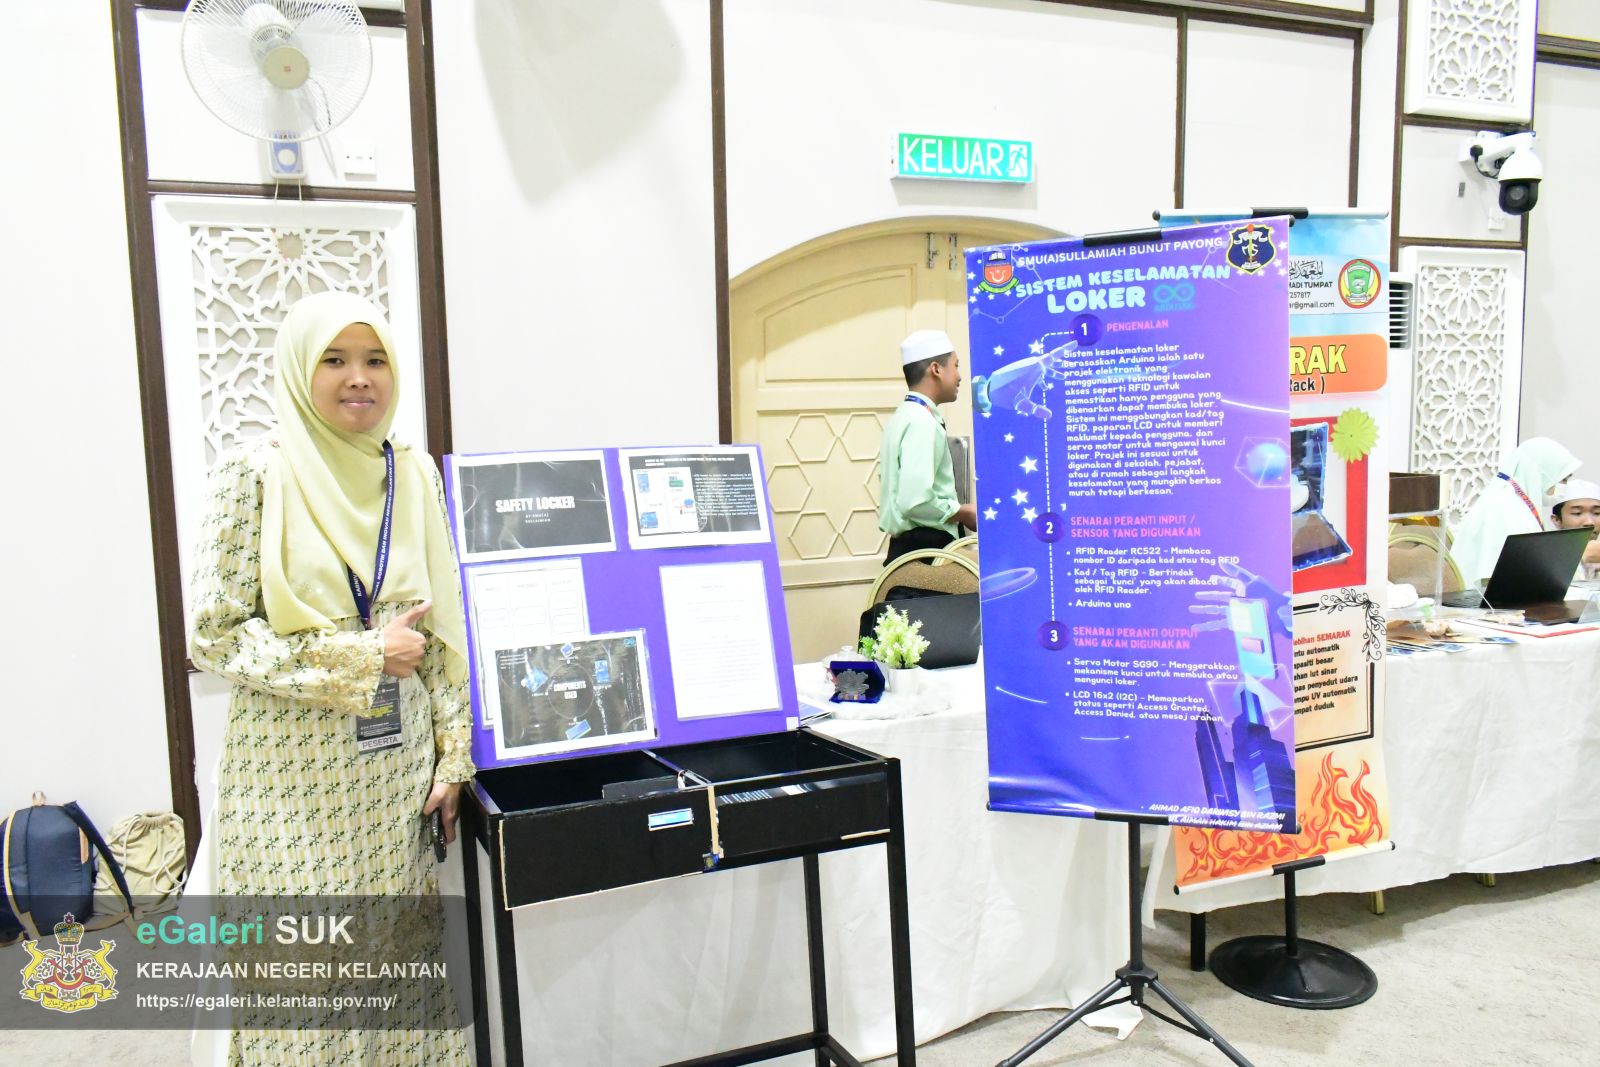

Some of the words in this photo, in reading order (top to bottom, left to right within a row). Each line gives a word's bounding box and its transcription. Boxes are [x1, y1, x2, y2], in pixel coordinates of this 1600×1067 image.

[903, 137, 1004, 176] KELUAR
[1018, 246, 1126, 267] SMU(A)SULLAMIAH
[1129, 242, 1170, 256] BUNUT
[1174, 237, 1222, 252] PAYONG
[1016, 277, 1083, 298] SISTEM
[1089, 265, 1231, 286] KESELAMATAN
[1046, 286, 1146, 314] LOKER
[1080, 323, 1087, 335] 1
[1107, 321, 1169, 332] PENGENALAN
[1064, 350, 1093, 358] Sistem
[1095, 346, 1153, 357] keselamatan
[1119, 356, 1155, 364] Arduino
[1064, 369, 1093, 378] projek
[1096, 365, 1141, 375] elektronik
[1128, 374, 1170, 383] teknologi
[1173, 372, 1211, 380] kawalan
[1093, 386, 1126, 395] seperti
[1154, 382, 1180, 390] untuk
[1066, 395, 1116, 405] memastikan
[1120, 394, 1147, 403] hanya
[1151, 392, 1194, 401] pengguna
[1066, 405, 1114, 414] dibenarkan
[1118, 404, 1144, 413] dapat
[1093, 424, 1131, 433] paparan
[1156, 420, 1181, 428] untuk
[1110, 432, 1142, 442] kepada
[1155, 439, 1199, 448] mengawal
[1094, 452, 1124, 460] Projek
[1068, 461, 1111, 470] digunakan
[1132, 468, 1167, 478] sebagai
[1170, 468, 1206, 476] langkah
[1126, 479, 1148, 488] yang
[1151, 478, 1186, 486] mungkin
[1098, 488, 1126, 497] tetapi
[496, 498, 533, 513] SAFETY
[536, 496, 575, 510] LOCKER
[1071, 516, 1112, 526] SENARAI
[1115, 515, 1156, 525] PERANTI
[1159, 514, 1187, 524] INPUT
[1046, 522, 1054, 534] 2
[1071, 528, 1109, 538] SENSOR
[1113, 528, 1138, 538] YANG
[1140, 527, 1201, 537] DIGUNAKAN
[1098, 547, 1128, 555] Reader
[1171, 547, 1211, 555] Membaca
[1074, 556, 1104, 564] nombor
[1118, 556, 1156, 566] daripada
[1200, 557, 1215, 566] tag
[1099, 568, 1115, 578] Tag
[1118, 569, 1138, 577] RFID
[1074, 578, 1107, 586] sebagai
[1140, 578, 1162, 587] yang
[1164, 578, 1186, 586] akan
[1075, 585, 1092, 593] oleh
[1076, 600, 1111, 608] Arduino
[1050, 630, 1058, 643] 3
[1072, 626, 1114, 636] SENARAI
[1117, 627, 1159, 638] PERANTI
[1161, 628, 1199, 638] OUTPUT
[1317, 630, 1351, 641] SEMARAK
[1074, 638, 1098, 647] YANG
[1101, 639, 1128, 648] AKAN
[1131, 640, 1190, 649] DIGUNAKAN
[1307, 644, 1340, 655] automatik
[1074, 658, 1101, 666] Servo
[1103, 659, 1130, 668] Motor
[1169, 662, 1236, 671] Menggerakkan
[1316, 657, 1334, 667] besar
[1074, 667, 1118, 676] mekanisme
[1121, 669, 1143, 677] kunci
[1145, 670, 1171, 678] untuk
[1174, 670, 1213, 679] membuka
[1216, 672, 1238, 680] atau
[1321, 668, 1337, 676] sinar
[1074, 677, 1113, 685] mengunci
[1073, 691, 1090, 699] LCD
[1093, 691, 1114, 700] 16x2
[1148, 695, 1204, 704] Memaparkan
[1312, 692, 1321, 700] UV
[1323, 686, 1356, 698] automatik
[1074, 699, 1101, 708] status
[1104, 700, 1134, 710] seperti
[1137, 703, 1168, 711] Access
[1314, 702, 1334, 710] duduk
[1074, 708, 1103, 717] Access
[1139, 711, 1159, 720] atau
[1162, 713, 1187, 721] mesej
[362, 736, 398, 749] PESERTA
[1149, 804, 1180, 812] AHMAD
